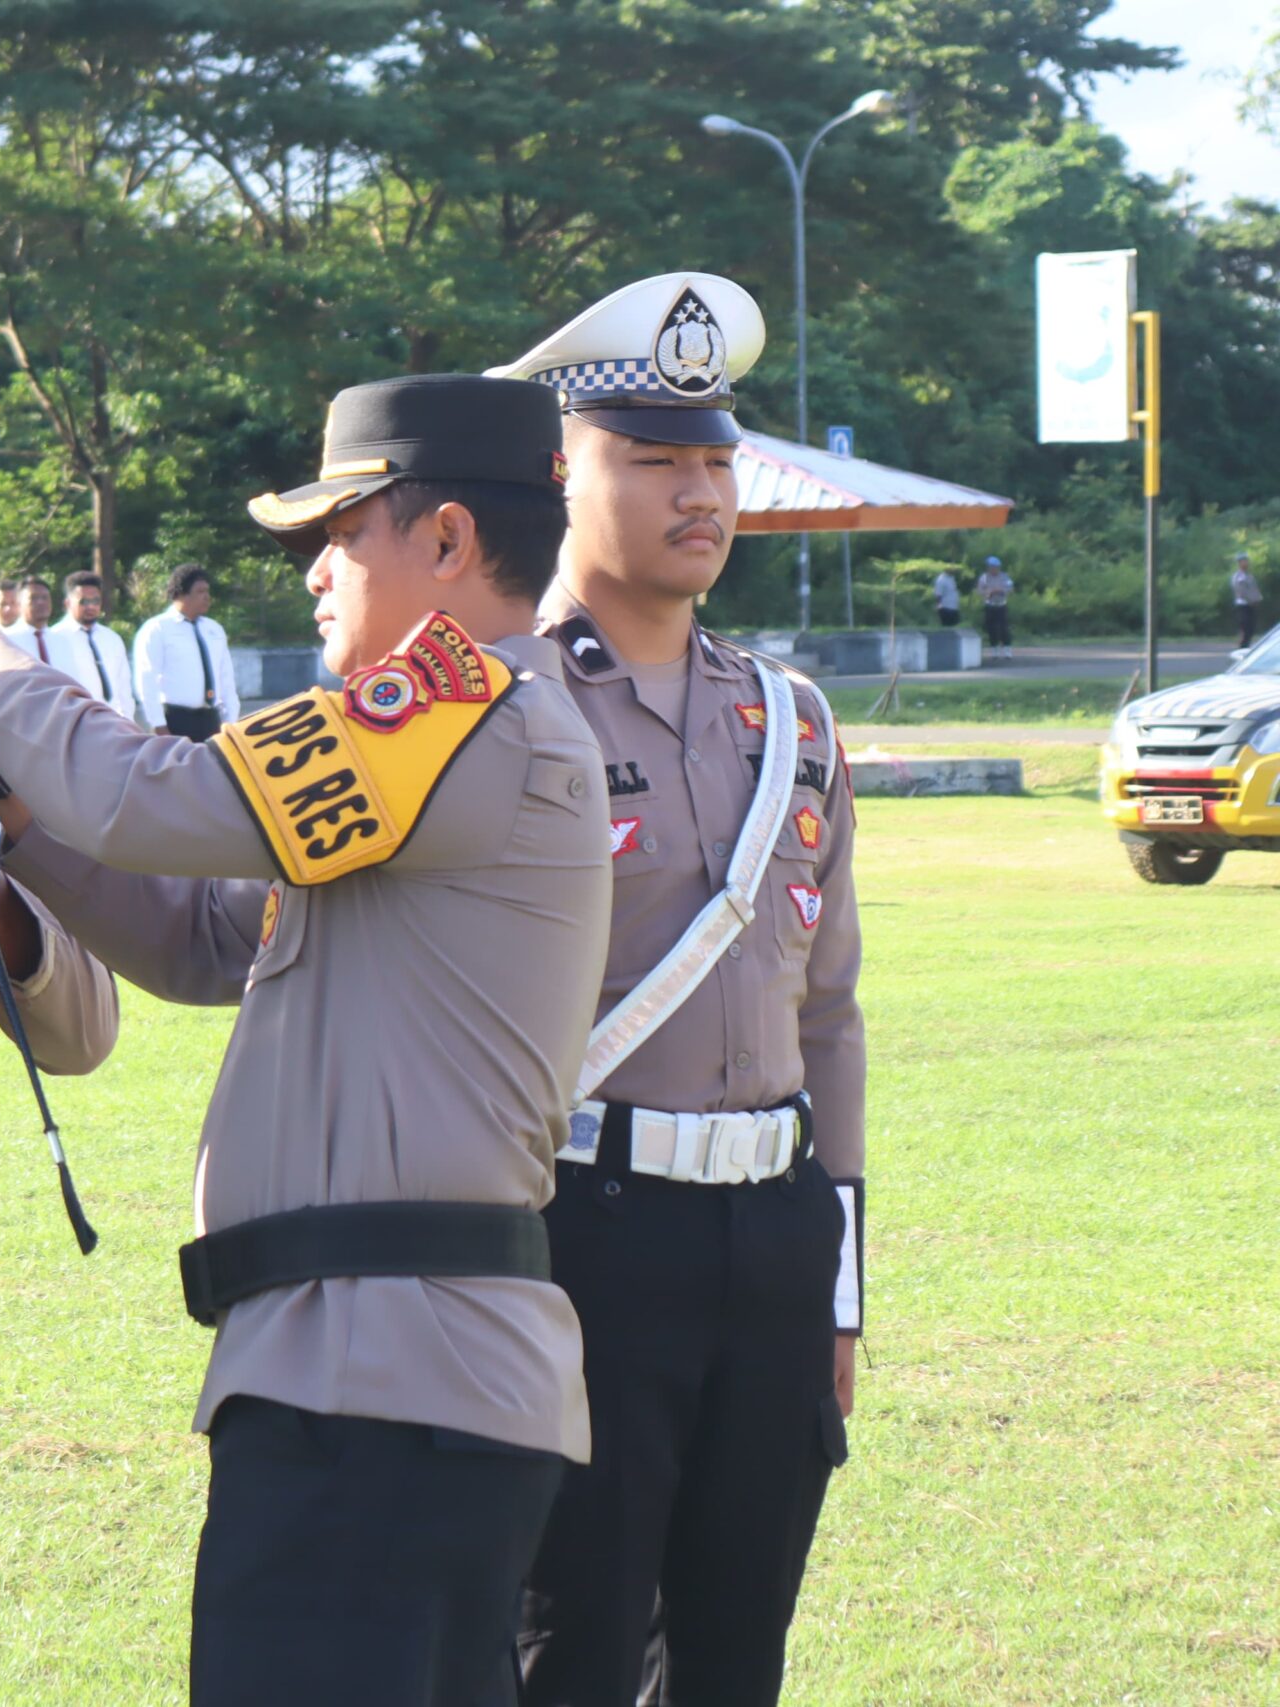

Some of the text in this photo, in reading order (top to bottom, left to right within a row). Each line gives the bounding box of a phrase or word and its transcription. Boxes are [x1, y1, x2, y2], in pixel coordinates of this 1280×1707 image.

[413, 643, 453, 696] MALUKU
[430, 619, 487, 695] POLRES
[244, 699, 380, 860] OPS RES
